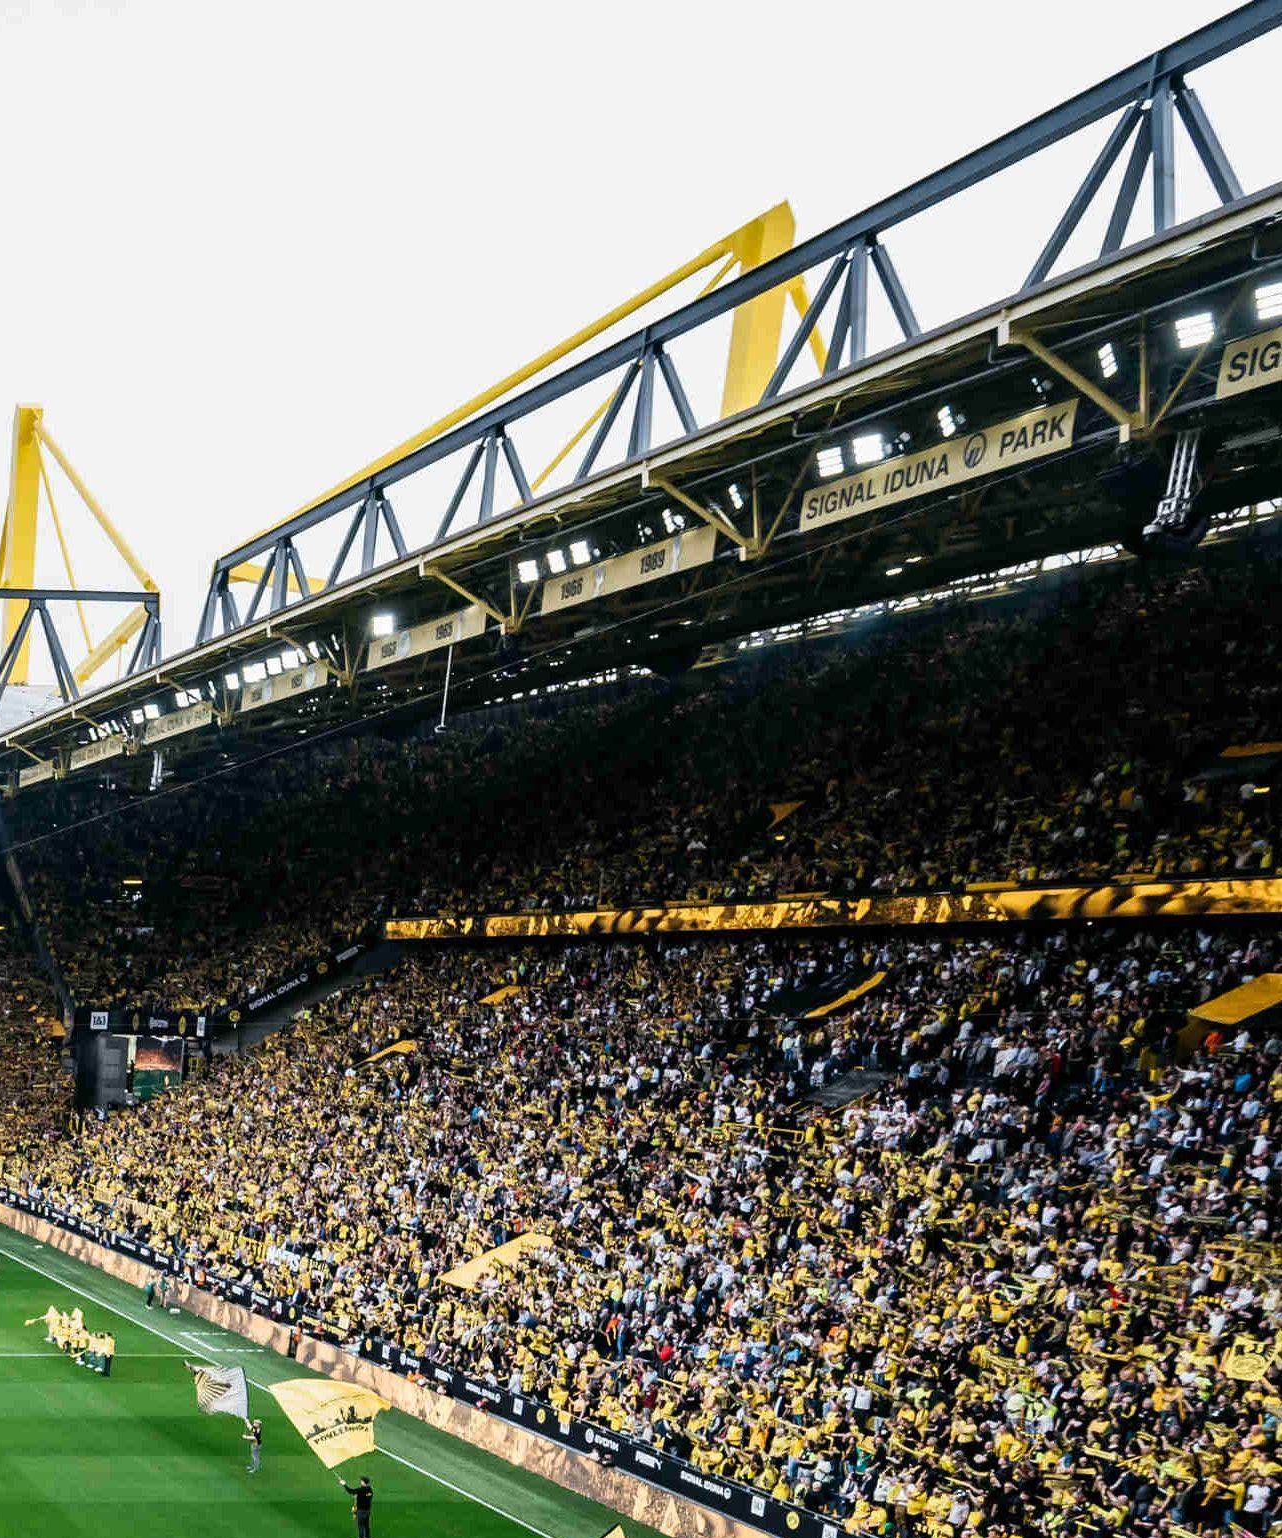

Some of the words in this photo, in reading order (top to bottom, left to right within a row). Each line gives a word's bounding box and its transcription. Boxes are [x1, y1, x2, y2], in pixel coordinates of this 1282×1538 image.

[806, 480, 877, 521] SIGNAL
[883, 453, 950, 496] IDUNA
[999, 411, 1066, 457] PARK
[641, 549, 666, 575] 1989
